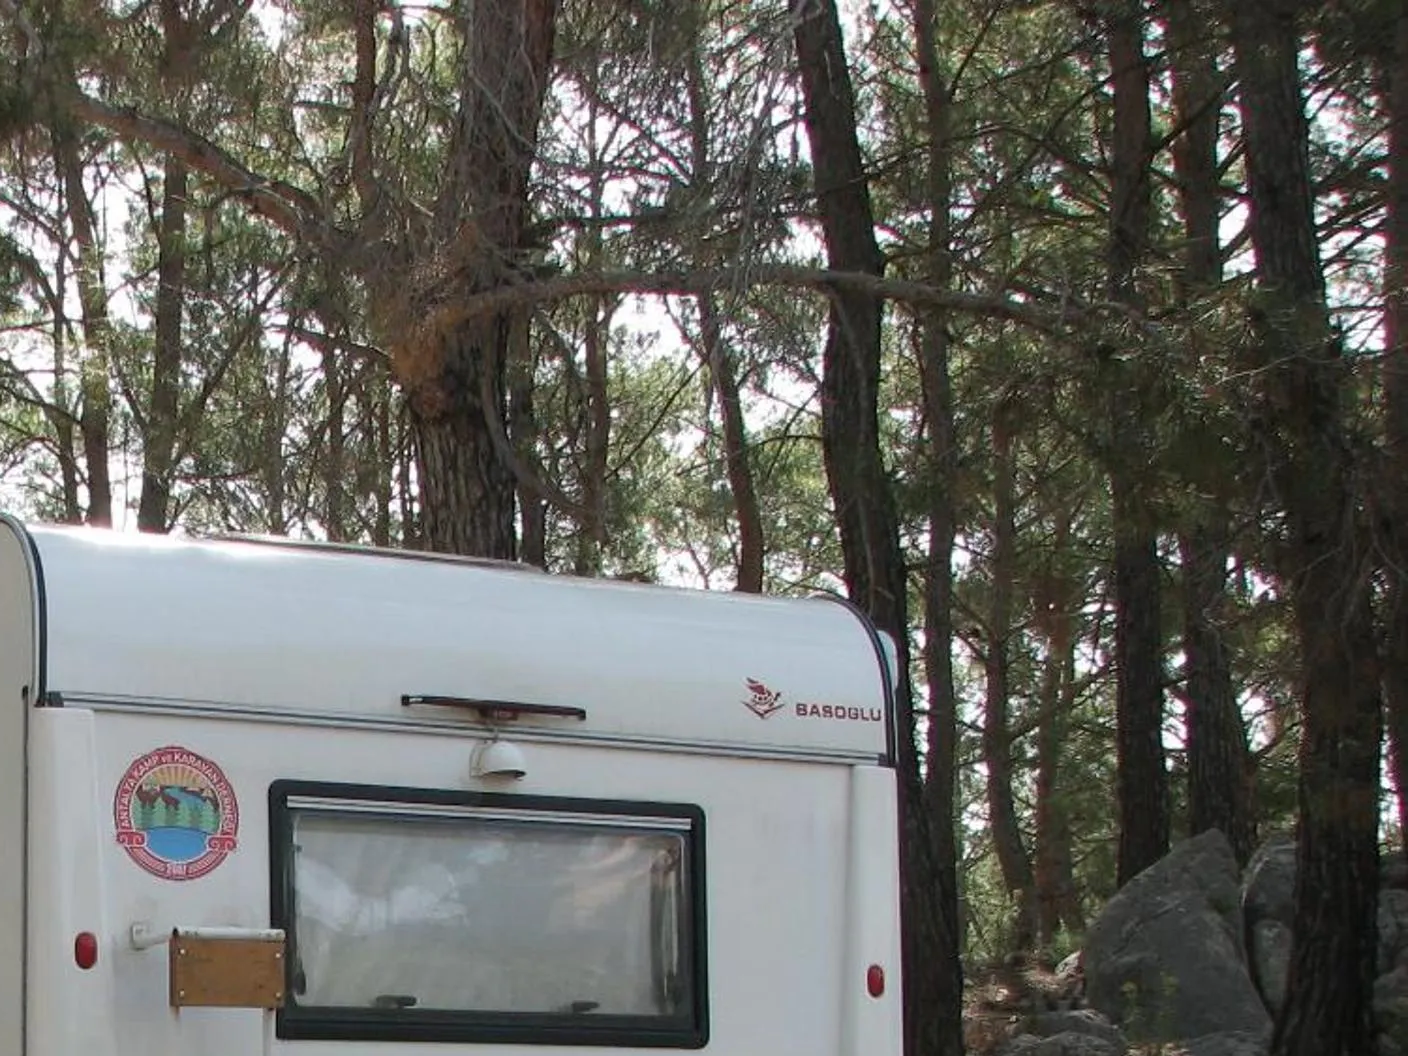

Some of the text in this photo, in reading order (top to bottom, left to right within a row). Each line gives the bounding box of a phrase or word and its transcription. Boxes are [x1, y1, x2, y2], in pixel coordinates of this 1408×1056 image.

[117, 776, 136, 828] ANTALYA
[133, 755, 162, 779] KAMP
[173, 751, 220, 784] KARAVAN
